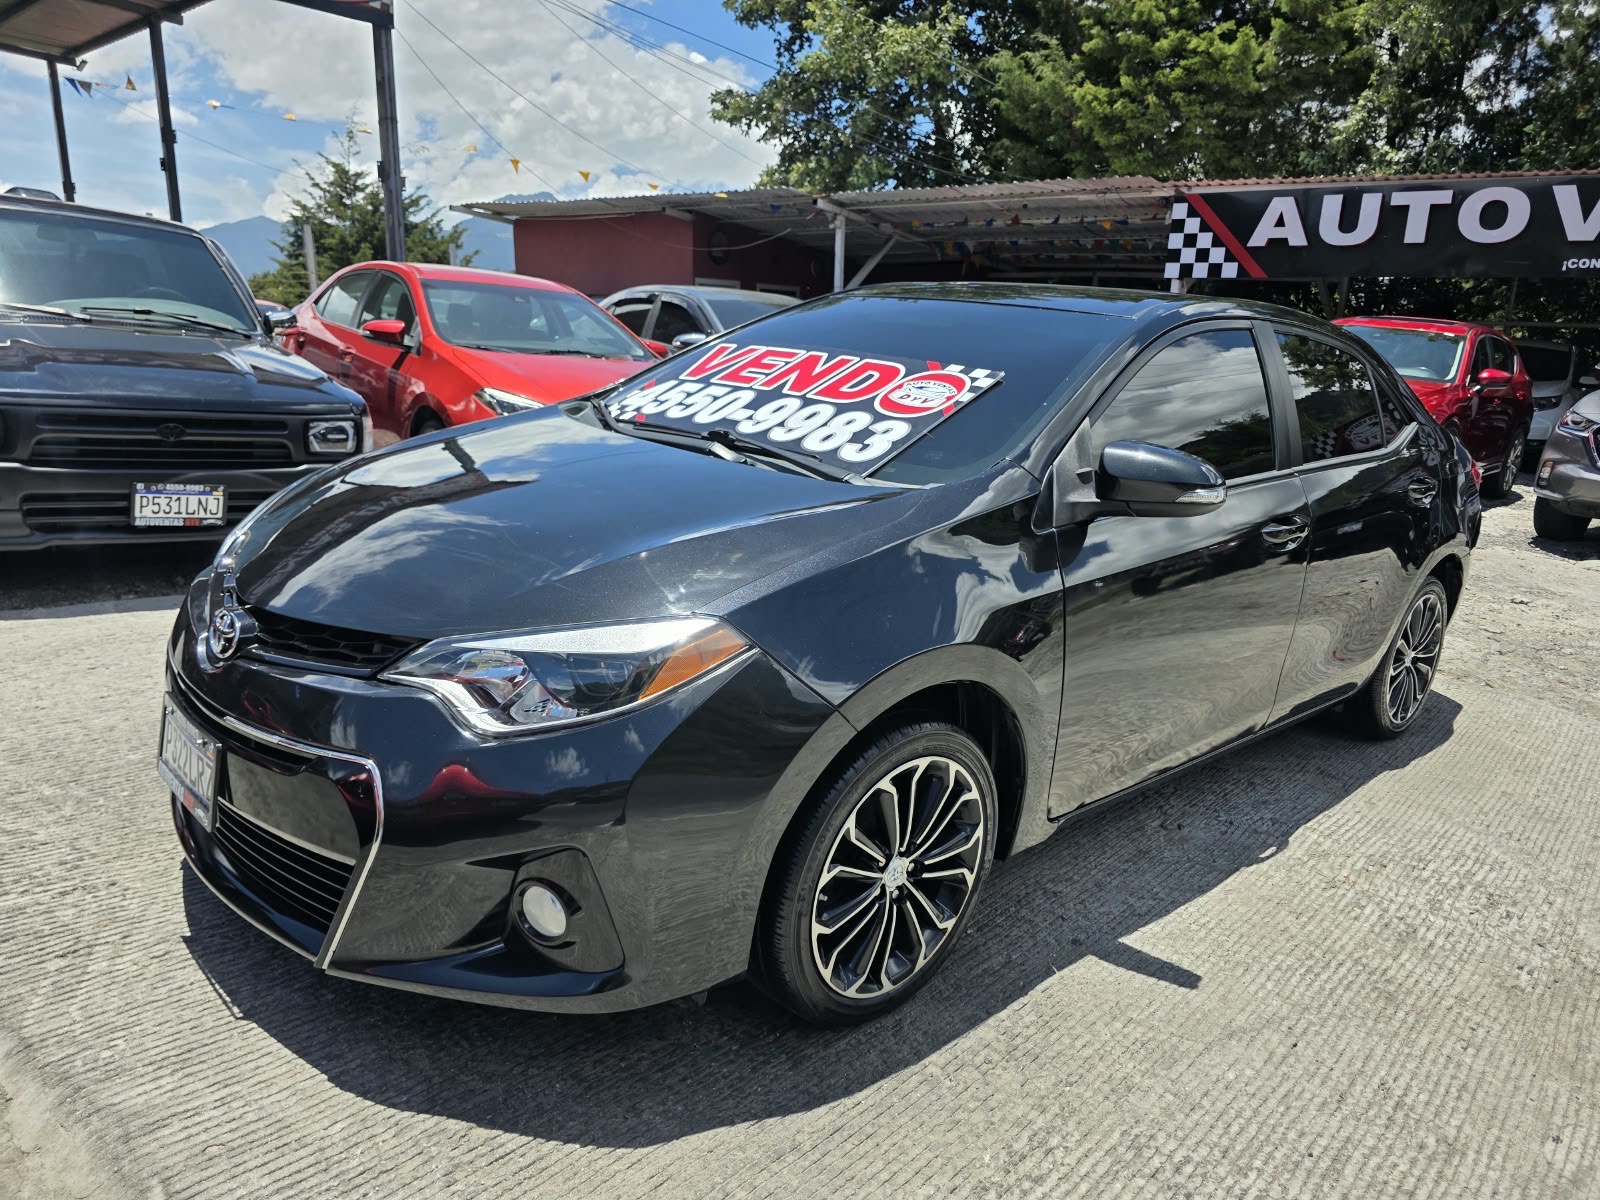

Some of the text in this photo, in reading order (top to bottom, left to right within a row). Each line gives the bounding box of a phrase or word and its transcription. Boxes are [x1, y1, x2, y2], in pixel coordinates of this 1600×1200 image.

[1246, 186, 1532, 248] AUTO
[898, 393, 935, 404] DYV
[619, 379, 912, 463] 4550-9983
[139, 495, 220, 516] P531LNJ
[134, 518, 184, 526] AUTOVENTAS
